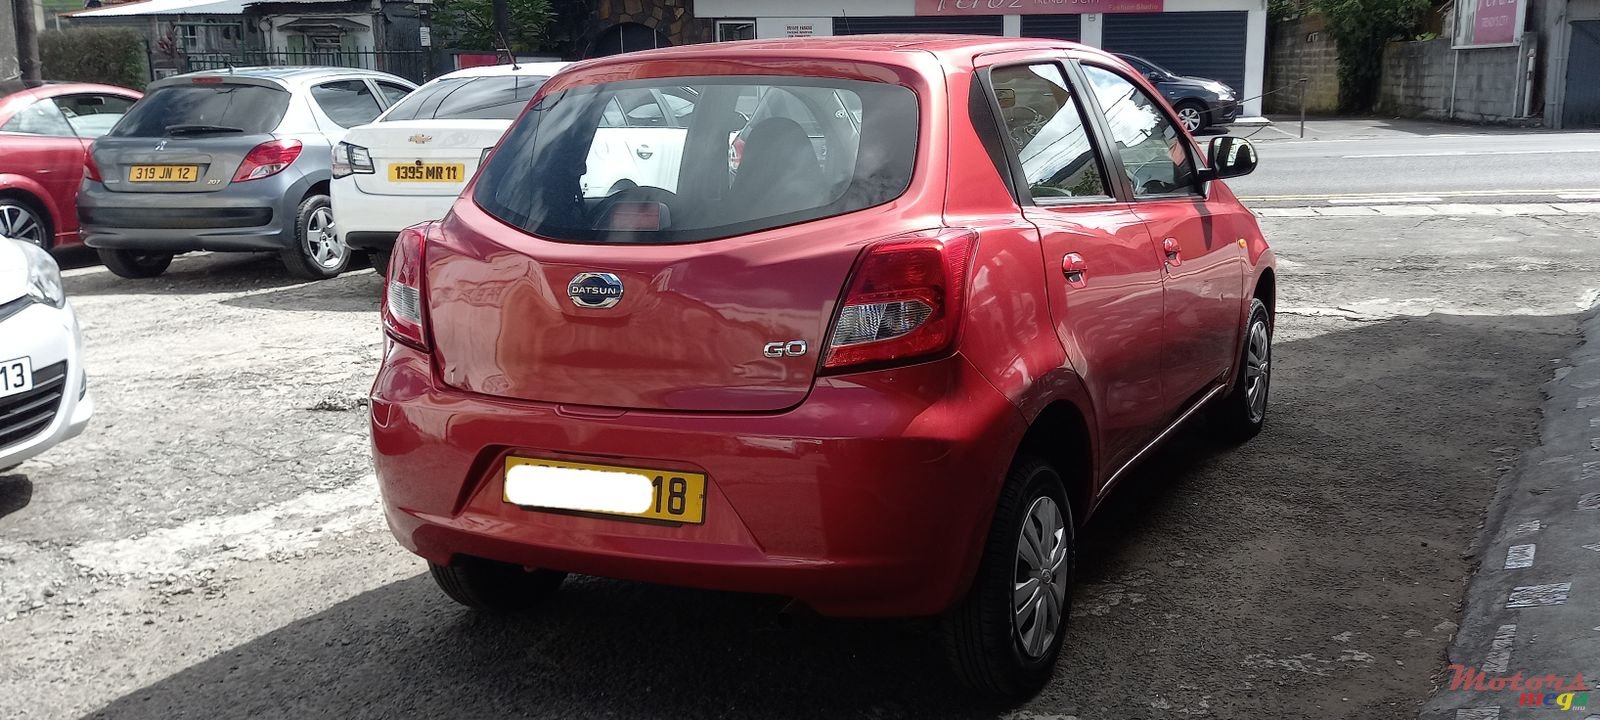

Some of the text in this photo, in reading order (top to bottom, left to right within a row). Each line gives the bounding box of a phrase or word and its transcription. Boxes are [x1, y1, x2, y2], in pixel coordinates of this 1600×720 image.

[136, 167, 190, 179] 319 JN 12
[395, 166, 457, 179] 1395 MR 11
[572, 286, 616, 295] DATSUN
[763, 340, 807, 358] GO
[0, 362, 25, 391] 13
[651, 475, 688, 516] 18
